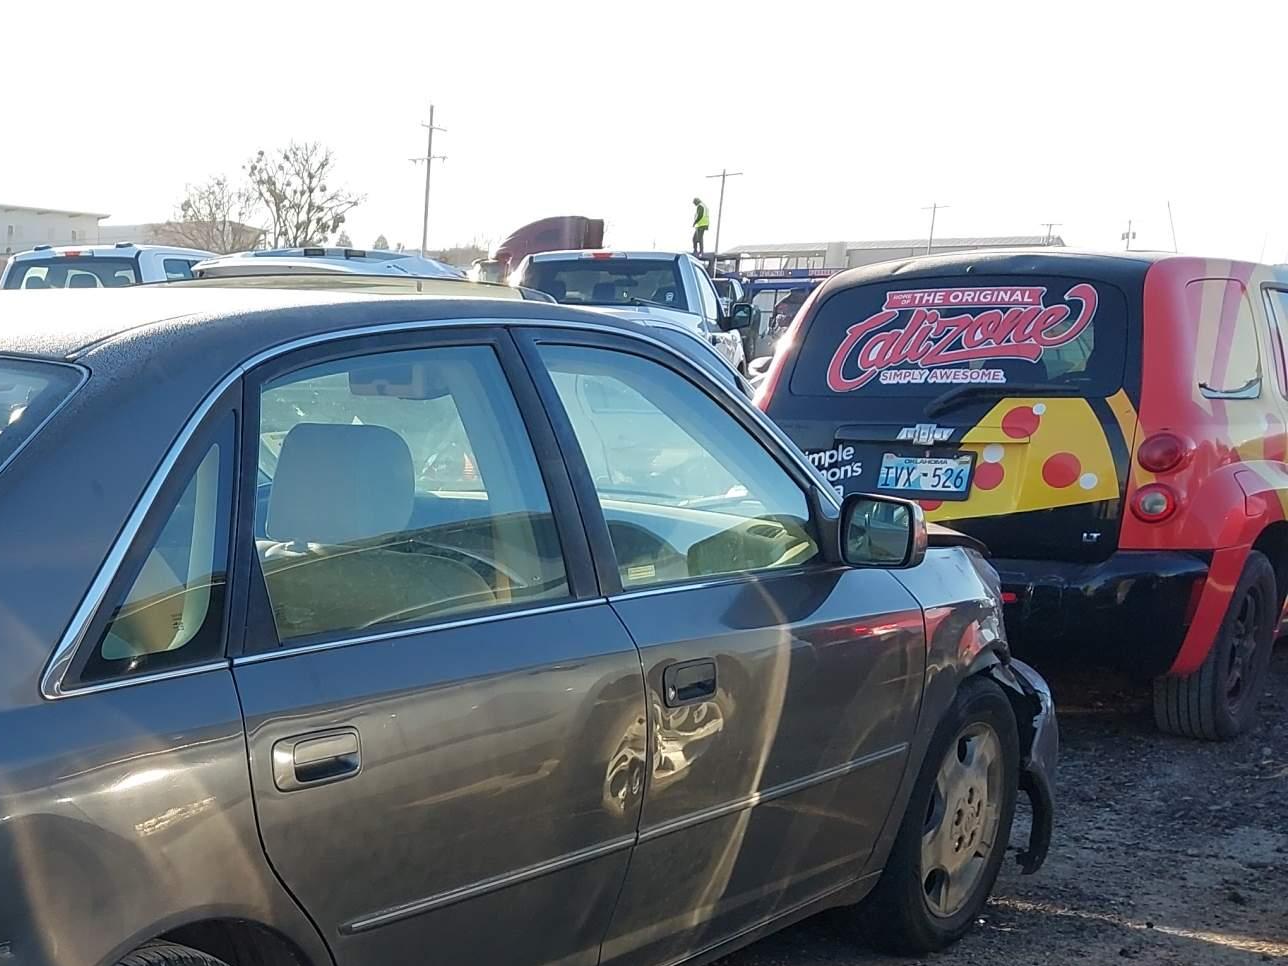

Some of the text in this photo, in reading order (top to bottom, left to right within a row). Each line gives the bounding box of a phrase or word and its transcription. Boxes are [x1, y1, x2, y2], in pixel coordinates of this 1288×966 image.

[914, 289, 1033, 304] THE ORIGINAL
[880, 370, 928, 383] SIMPLY
[805, 444, 855, 468] imple
